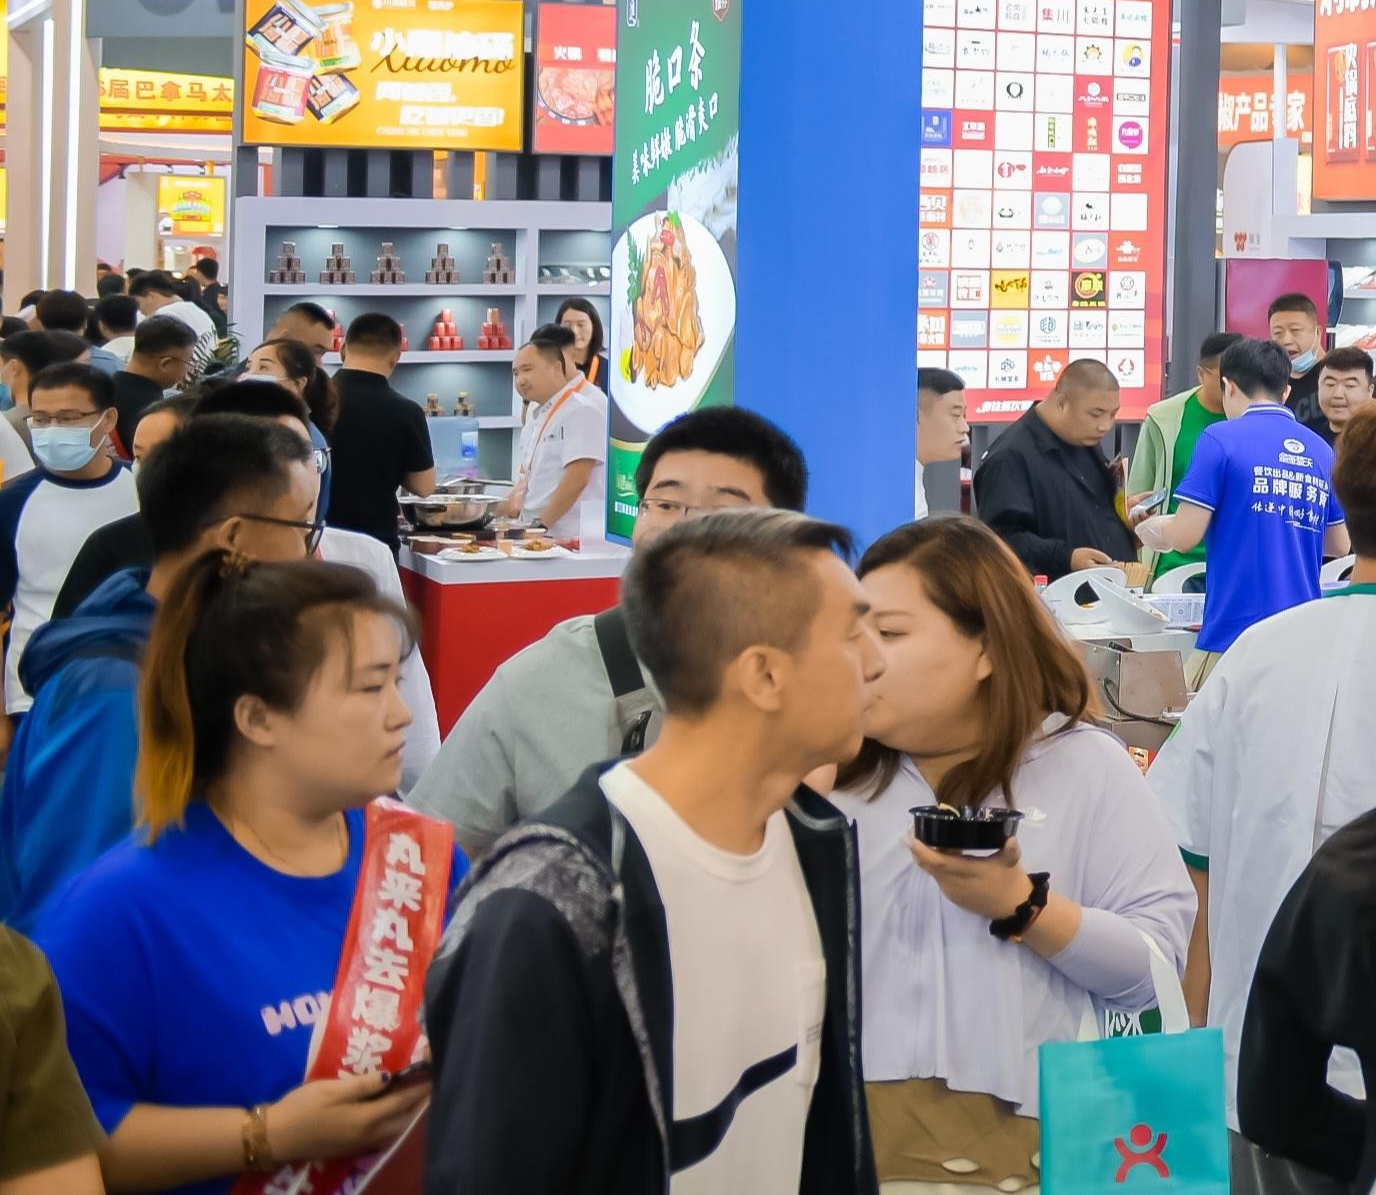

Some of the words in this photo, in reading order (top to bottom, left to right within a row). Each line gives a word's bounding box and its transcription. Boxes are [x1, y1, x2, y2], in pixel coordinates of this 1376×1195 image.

[644, 20, 706, 115] 脆口条
[338, 831, 426, 1080] 丸来丸去爆浆
